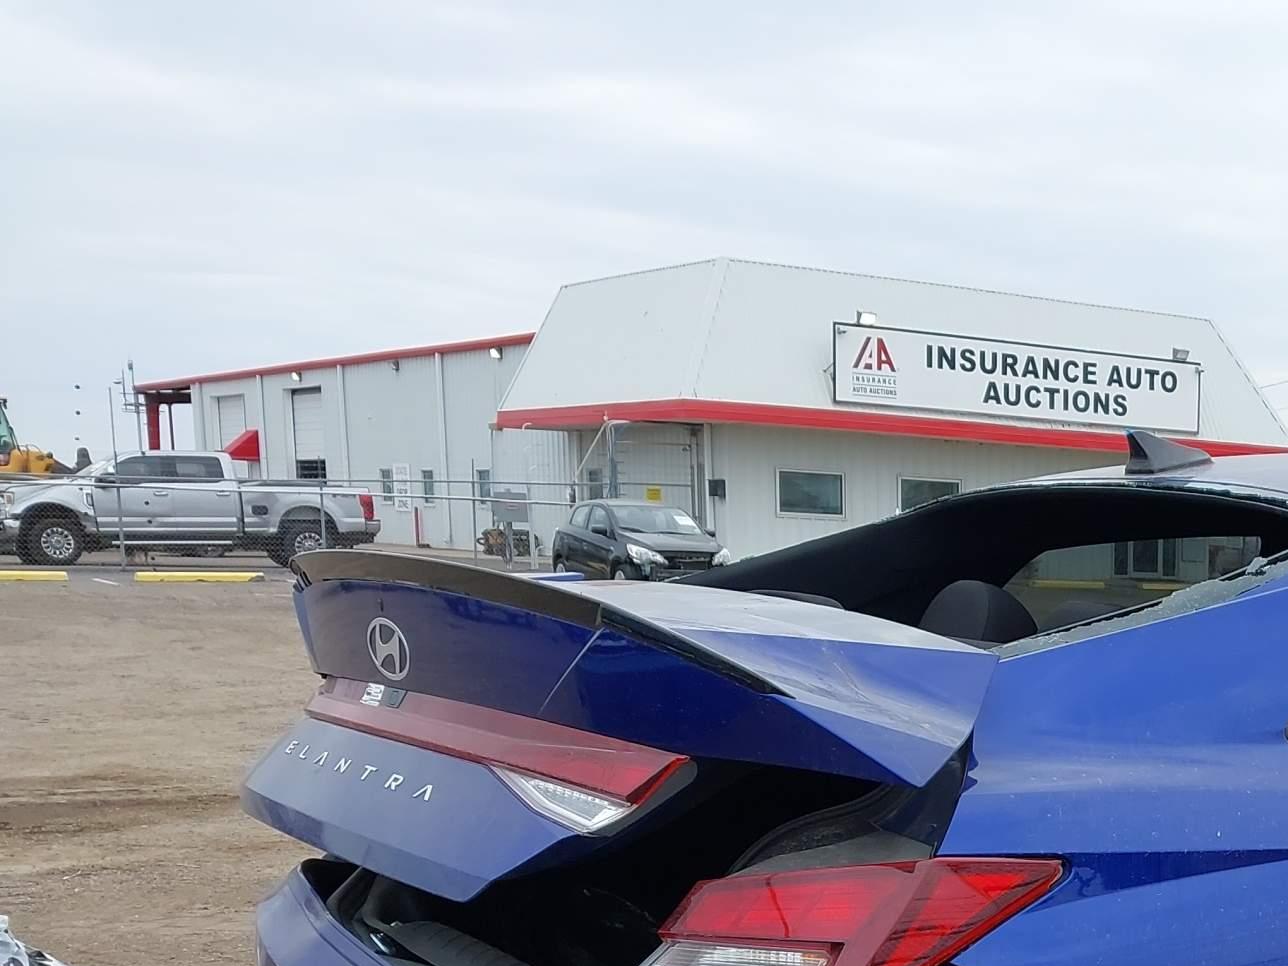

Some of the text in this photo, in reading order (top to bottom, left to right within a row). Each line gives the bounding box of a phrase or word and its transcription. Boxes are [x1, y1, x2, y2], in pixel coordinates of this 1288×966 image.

[852, 375, 897, 386] INSURANCE
[926, 344, 1178, 393] INSURANCE AUTO
[868, 387, 897, 396] AUCTIONS
[982, 381, 1128, 416] AUCTIONS
[285, 741, 433, 801] ELANTRA
